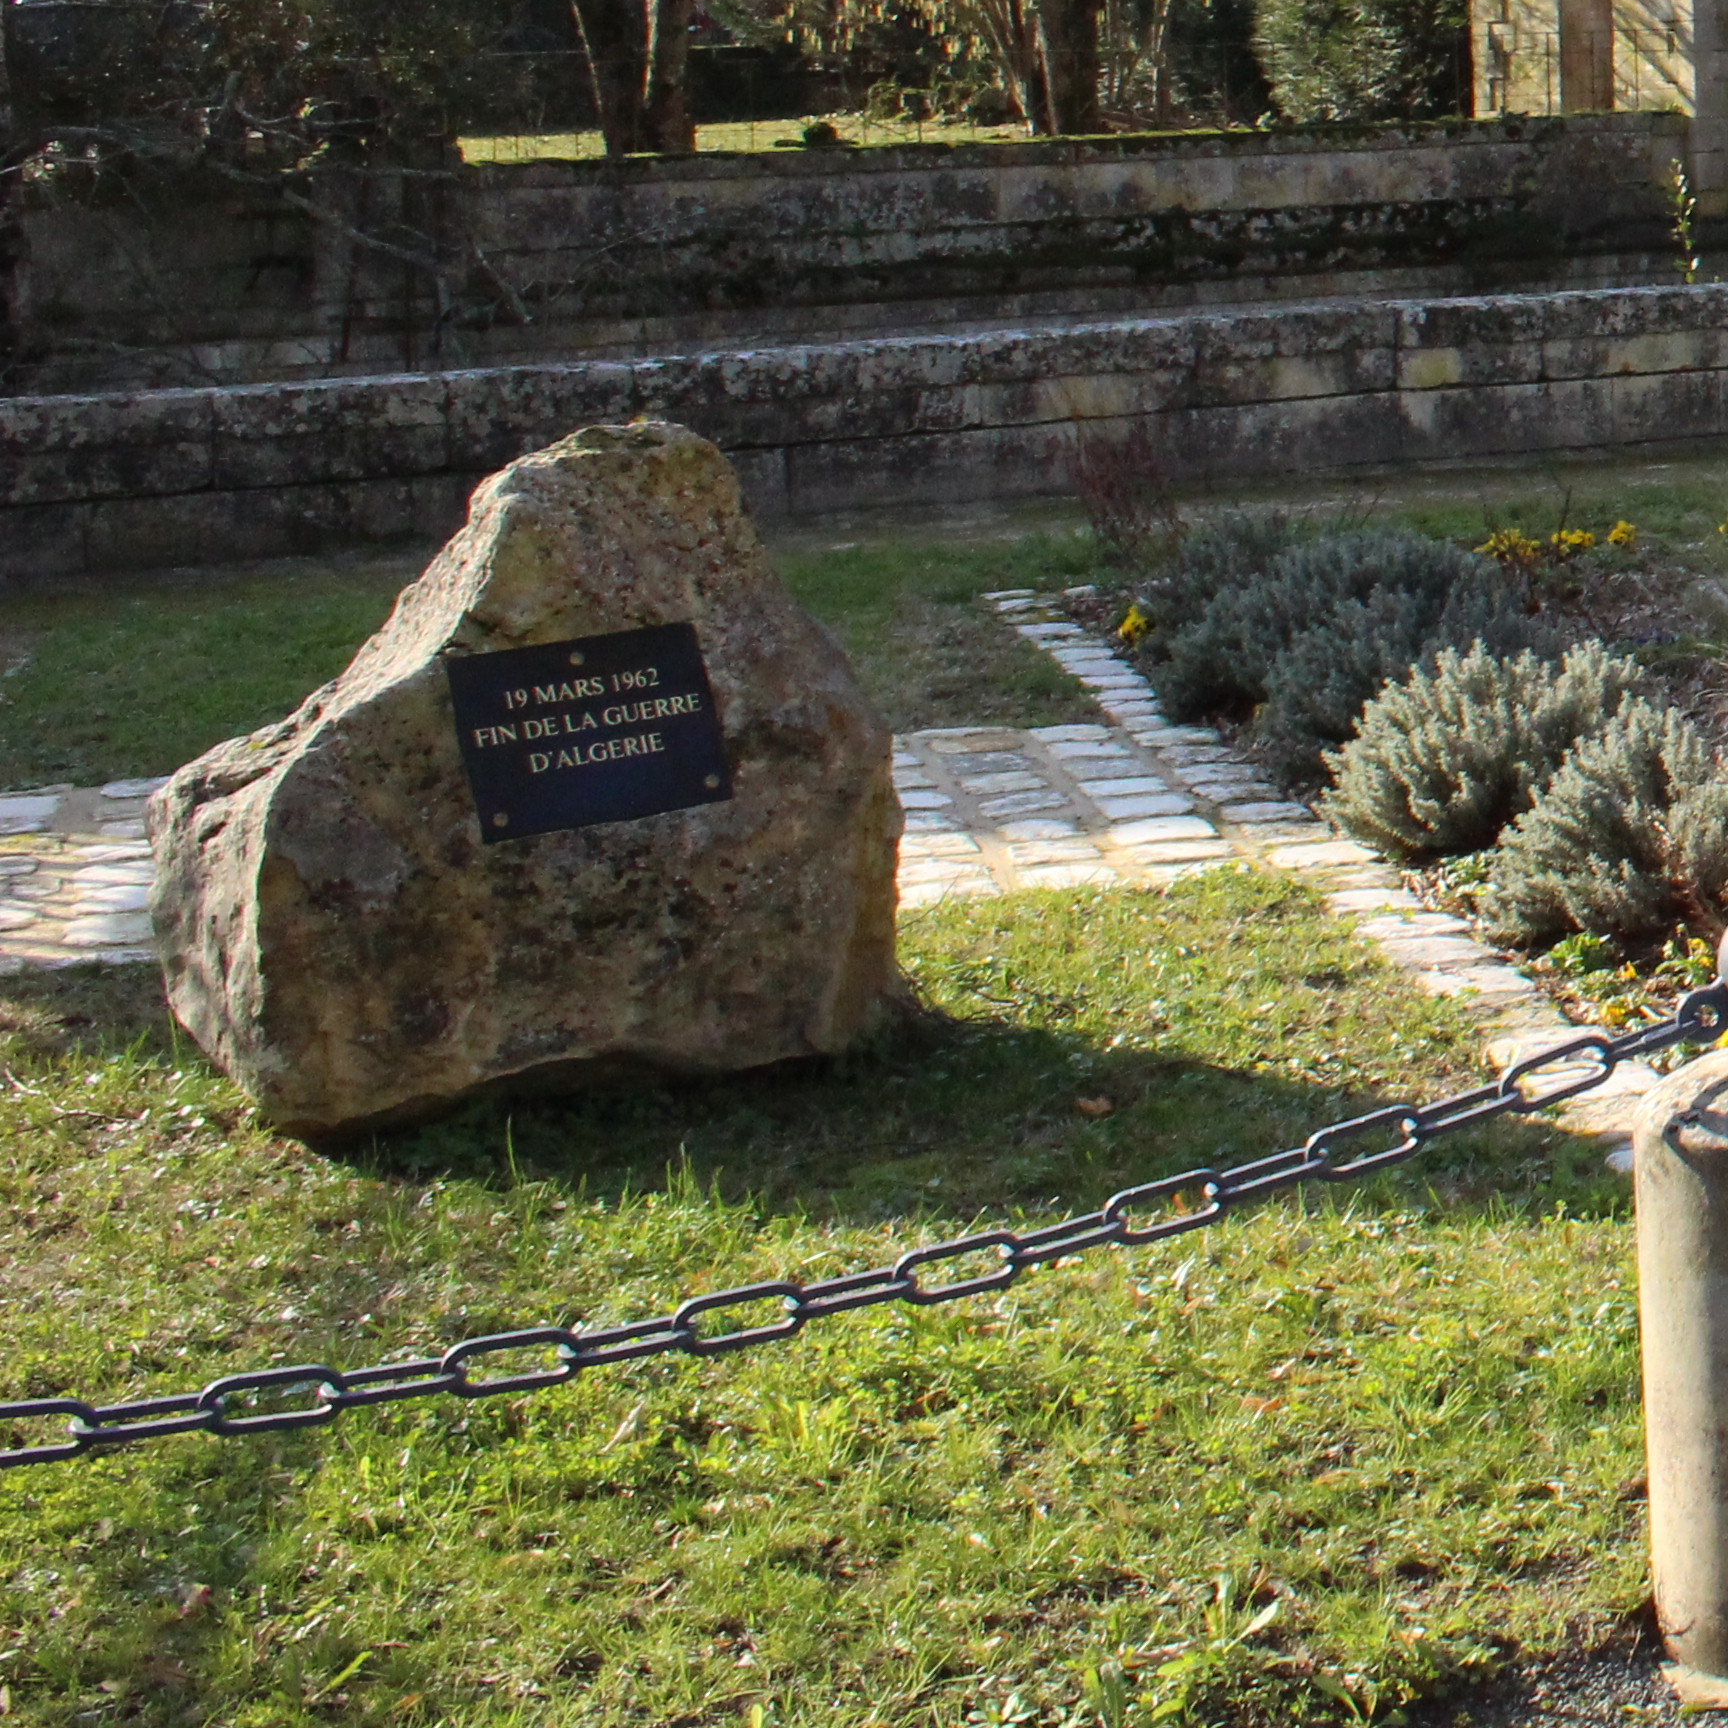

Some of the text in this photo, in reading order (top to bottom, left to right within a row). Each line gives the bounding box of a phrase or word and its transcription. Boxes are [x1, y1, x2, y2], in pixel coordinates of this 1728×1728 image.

[503, 667, 660, 710] 19 MARS 1962
[472, 692, 703, 748] FIN DE LA GUERRE
[529, 732, 665, 773] D'ALGERIE
